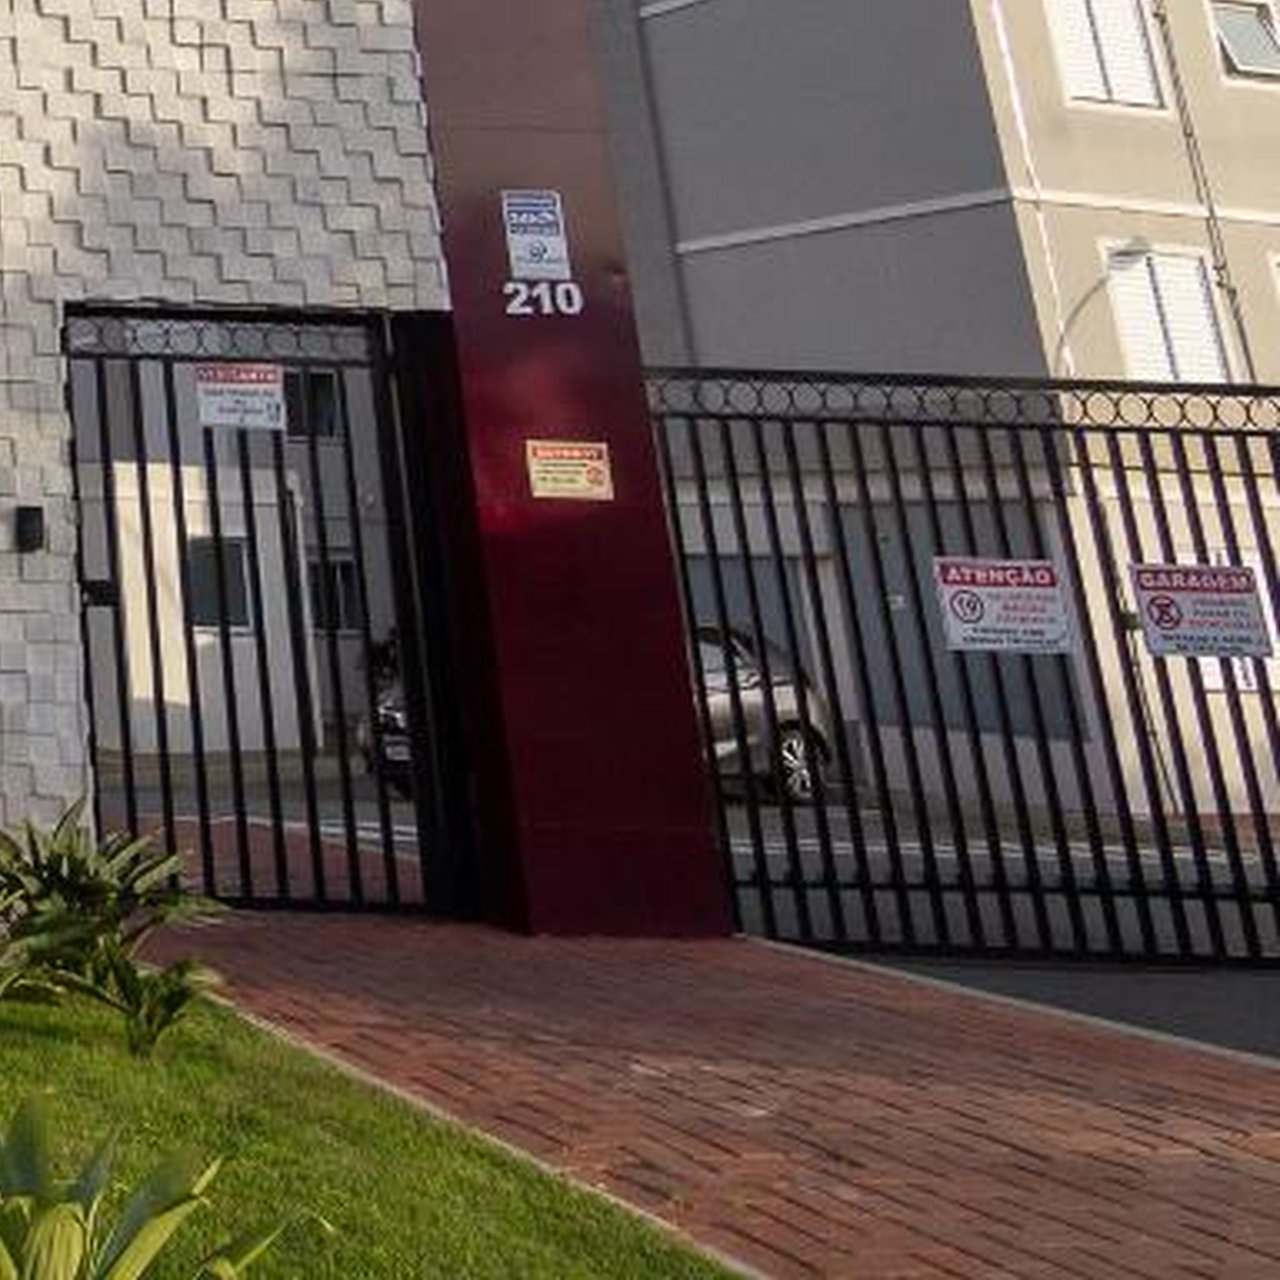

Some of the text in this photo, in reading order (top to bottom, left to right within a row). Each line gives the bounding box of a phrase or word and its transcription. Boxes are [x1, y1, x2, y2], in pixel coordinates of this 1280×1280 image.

[502, 282, 583, 314] 210
[946, 566, 1051, 585] ATENÇÃO
[1141, 573, 1250, 590] GARAGEM
